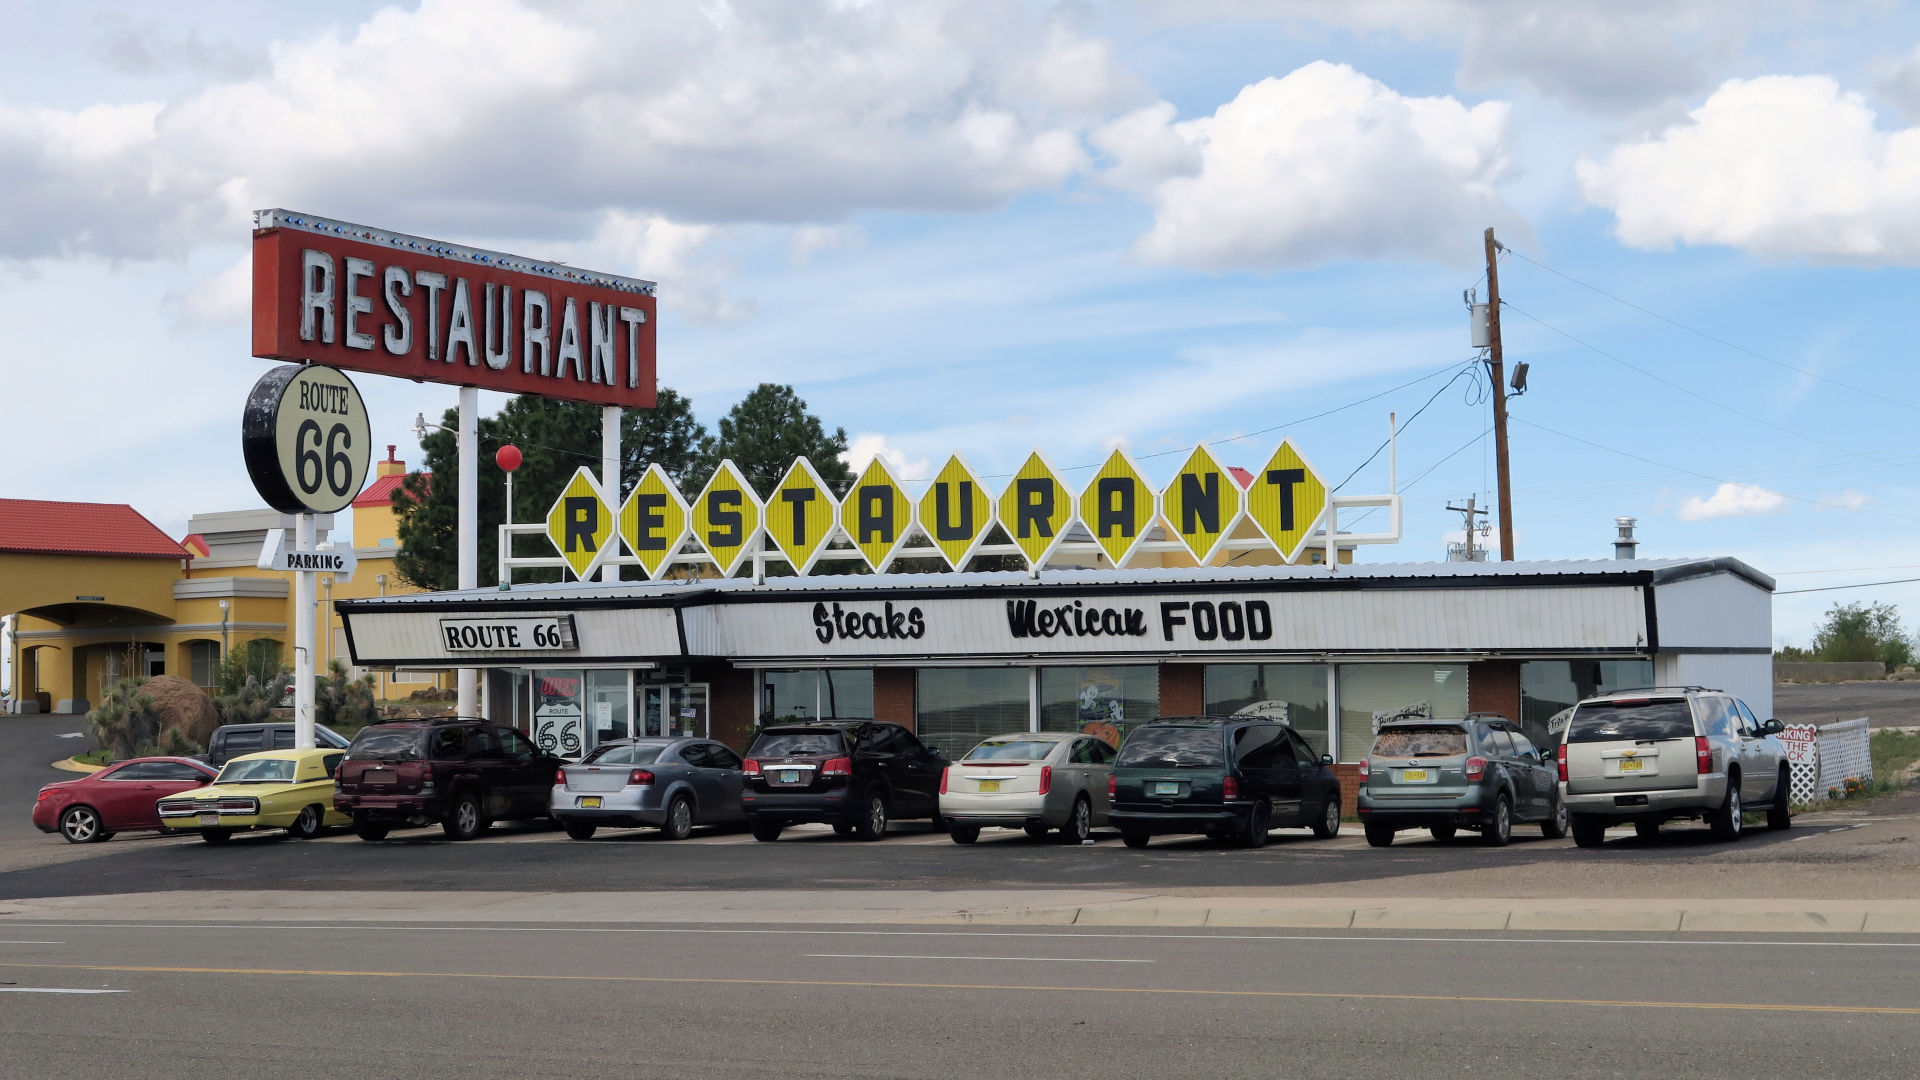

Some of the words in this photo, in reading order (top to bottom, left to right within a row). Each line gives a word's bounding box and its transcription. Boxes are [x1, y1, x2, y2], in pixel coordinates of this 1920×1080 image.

[300, 248, 648, 389] RESTAURANT
[299, 380, 349, 416] ROUTE
[295, 419, 352, 497] 66
[564, 468, 1306, 552] RESTAURANT
[287, 553, 344, 569] PARKING
[445, 625, 521, 649] ROUTE
[533, 623, 561, 648] 66
[812, 602, 926, 644] Steaks
[1007, 599, 1147, 639] Mexican
[1160, 600, 1273, 641] FOOD
[541, 677, 578, 697] OPEN
[538, 721, 580, 751] 66
[1773, 729, 1811, 740] ARKING
[1786, 740, 1809, 752] THE
